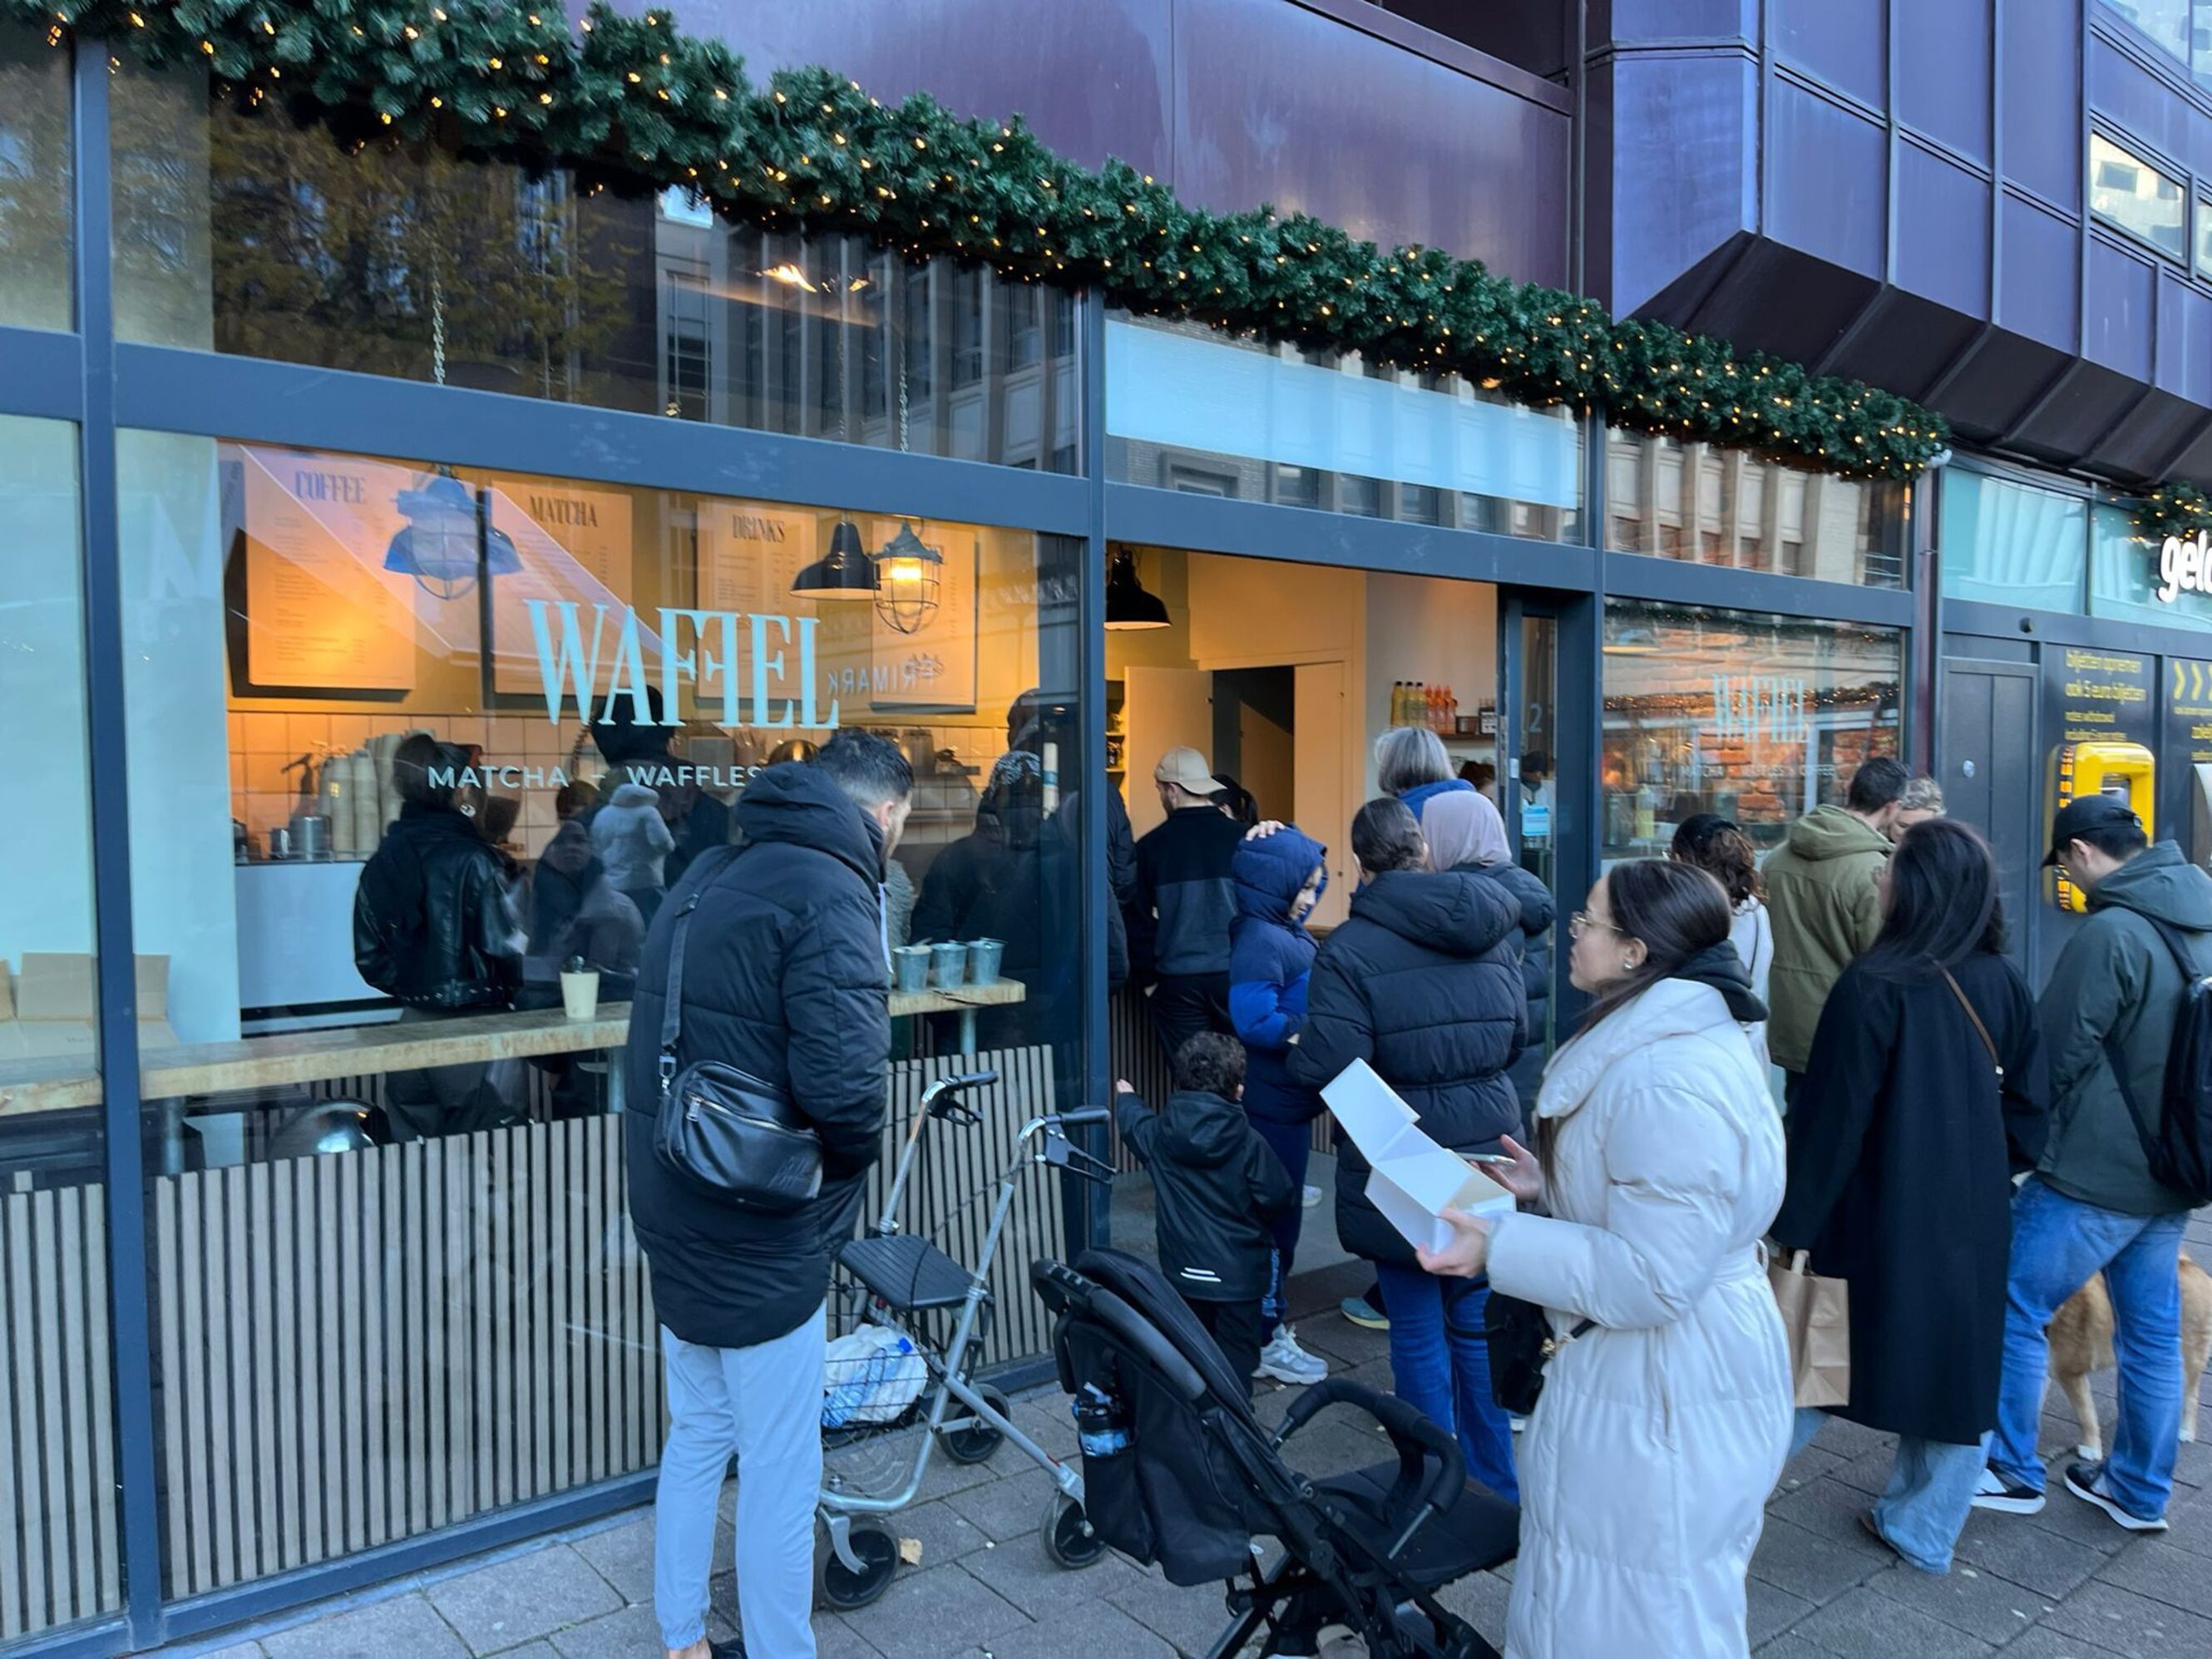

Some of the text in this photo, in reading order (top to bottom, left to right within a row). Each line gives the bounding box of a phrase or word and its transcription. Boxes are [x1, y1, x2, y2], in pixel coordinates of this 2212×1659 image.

[295, 470, 366, 504] COFFEE
[530, 495, 598, 527] MATCHA
[733, 514, 785, 544] DRINKS
[522, 599, 839, 729] WAFFEL
[1529, 704, 1543, 733] 2
[427, 764, 570, 789] MATCHA
